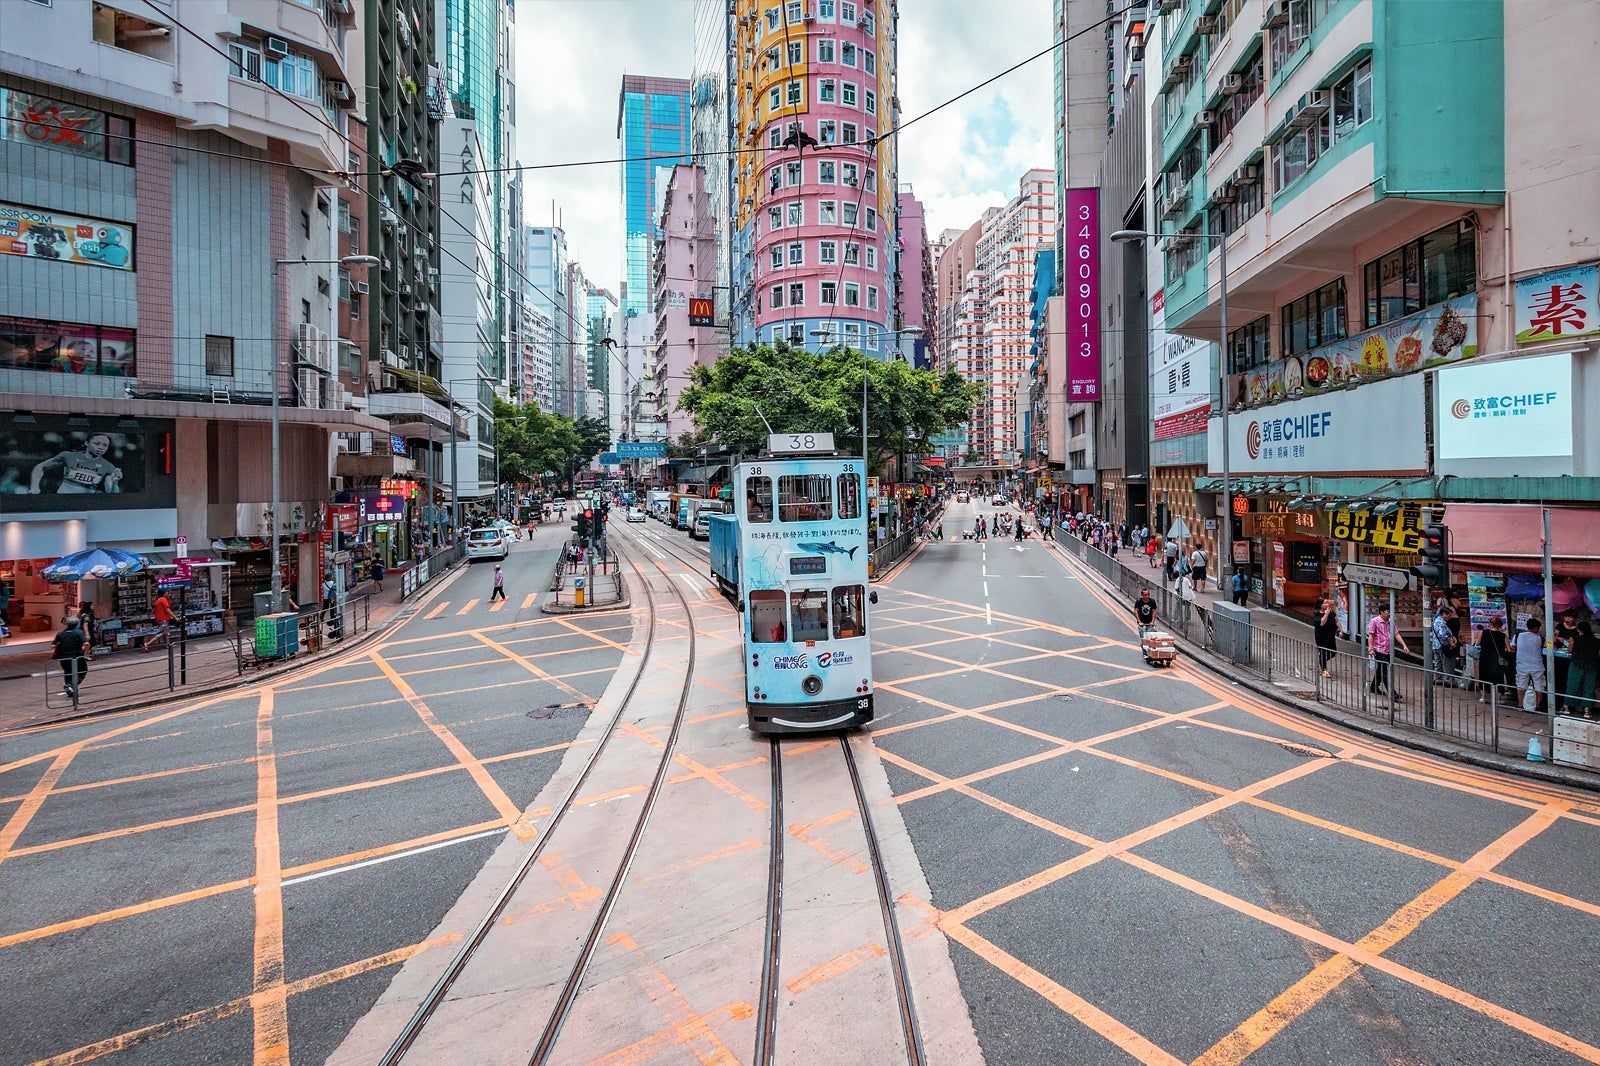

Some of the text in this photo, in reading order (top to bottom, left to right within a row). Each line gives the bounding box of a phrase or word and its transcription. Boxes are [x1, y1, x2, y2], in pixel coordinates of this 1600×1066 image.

[461, 128, 473, 204] TAKAN
[0, 208, 52, 224] SSROOM
[0, 228, 18, 237] tre
[74, 240, 100, 252] Dash
[1079, 205, 1091, 357] 34609013
[1521, 268, 1593, 287] Vegan Cuisine 2/F
[1528, 283, 1587, 337] 素
[1072, 385, 1095, 394] 查詢
[1474, 392, 1557, 410] 致富 CHIEF
[1262, 412, 1331, 442] 致富 CHIEF
[789, 435, 815, 449] 38
[750, 467, 762, 475] 38
[843, 464, 854, 472] 38
[75, 472, 96, 483] FELIX
[257, 522, 300, 531] PRME
[857, 699, 869, 709] 38
